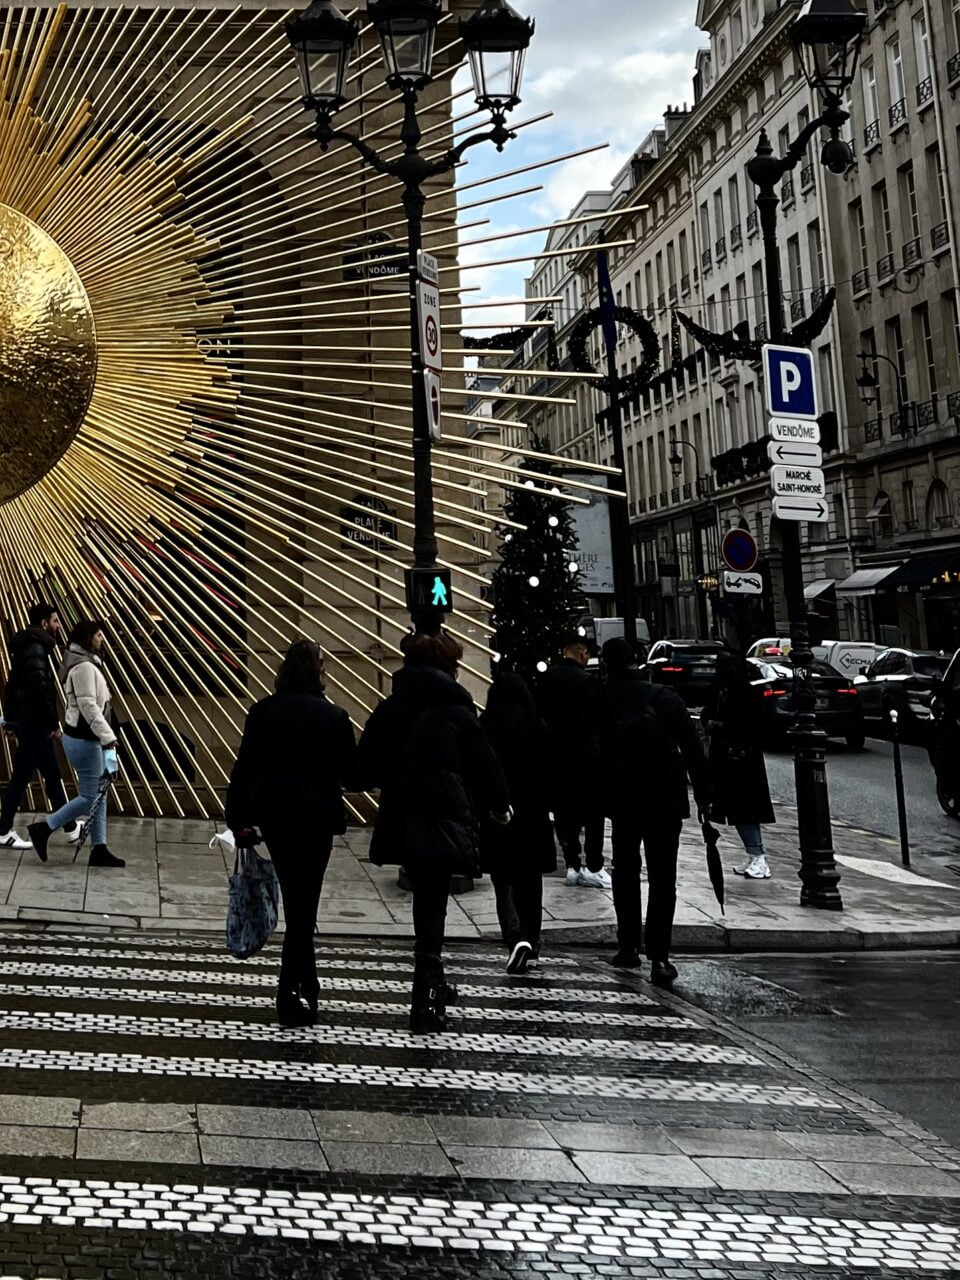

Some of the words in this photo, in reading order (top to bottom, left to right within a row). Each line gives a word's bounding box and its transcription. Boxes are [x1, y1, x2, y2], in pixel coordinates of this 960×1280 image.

[423, 293, 436, 308] ZONE
[427, 326, 436, 345] 30
[780, 360, 801, 403] P
[776, 424, 815, 439] VENDÔME
[785, 469, 812, 481] MARCHÉ
[777, 482, 823, 495] SAINT-HONORÉ
